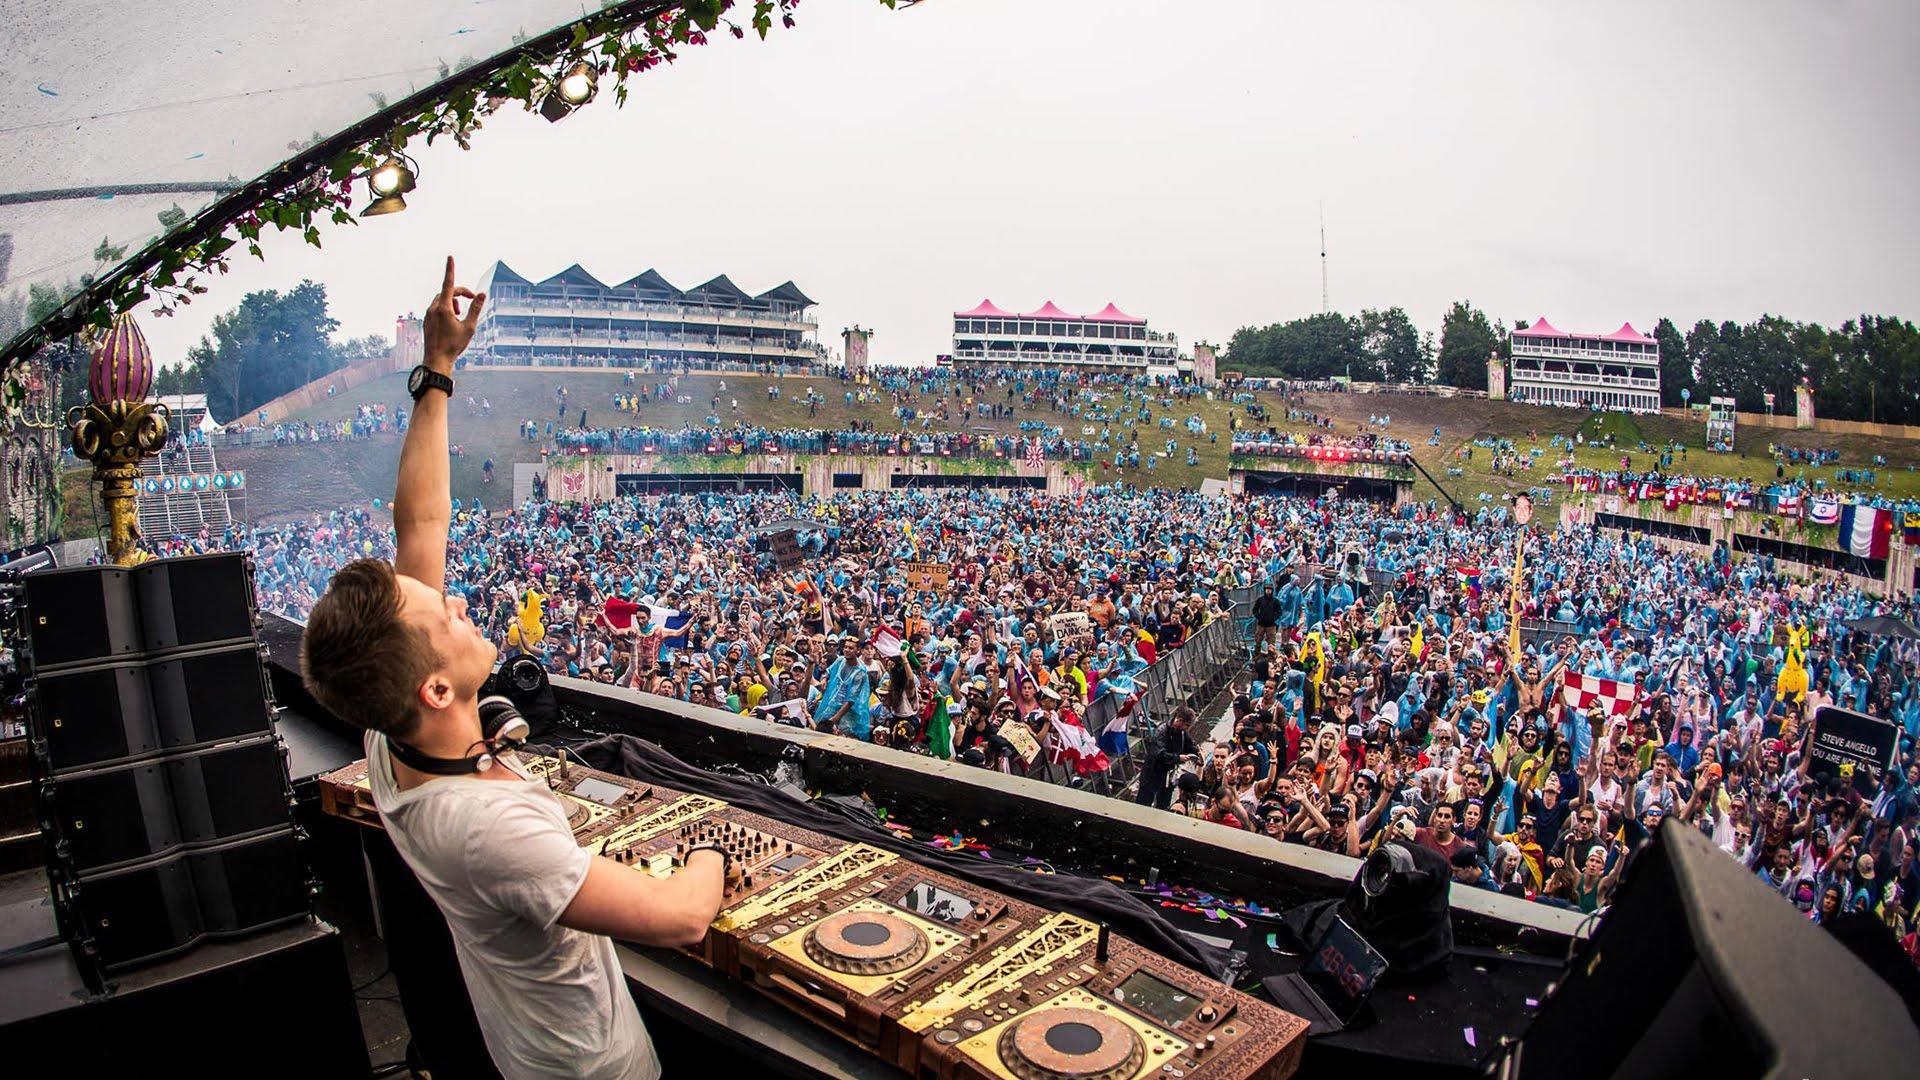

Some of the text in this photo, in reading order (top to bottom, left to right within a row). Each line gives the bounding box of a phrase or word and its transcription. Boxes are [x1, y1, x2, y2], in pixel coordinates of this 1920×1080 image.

[908, 564, 948, 575] UNITED
[908, 581, 944, 590] WE ARE
[1821, 733, 1877, 756] STEVE ANGELLO
[1825, 753, 1840, 765] ARE
[1857, 762, 1882, 777] ALNE
